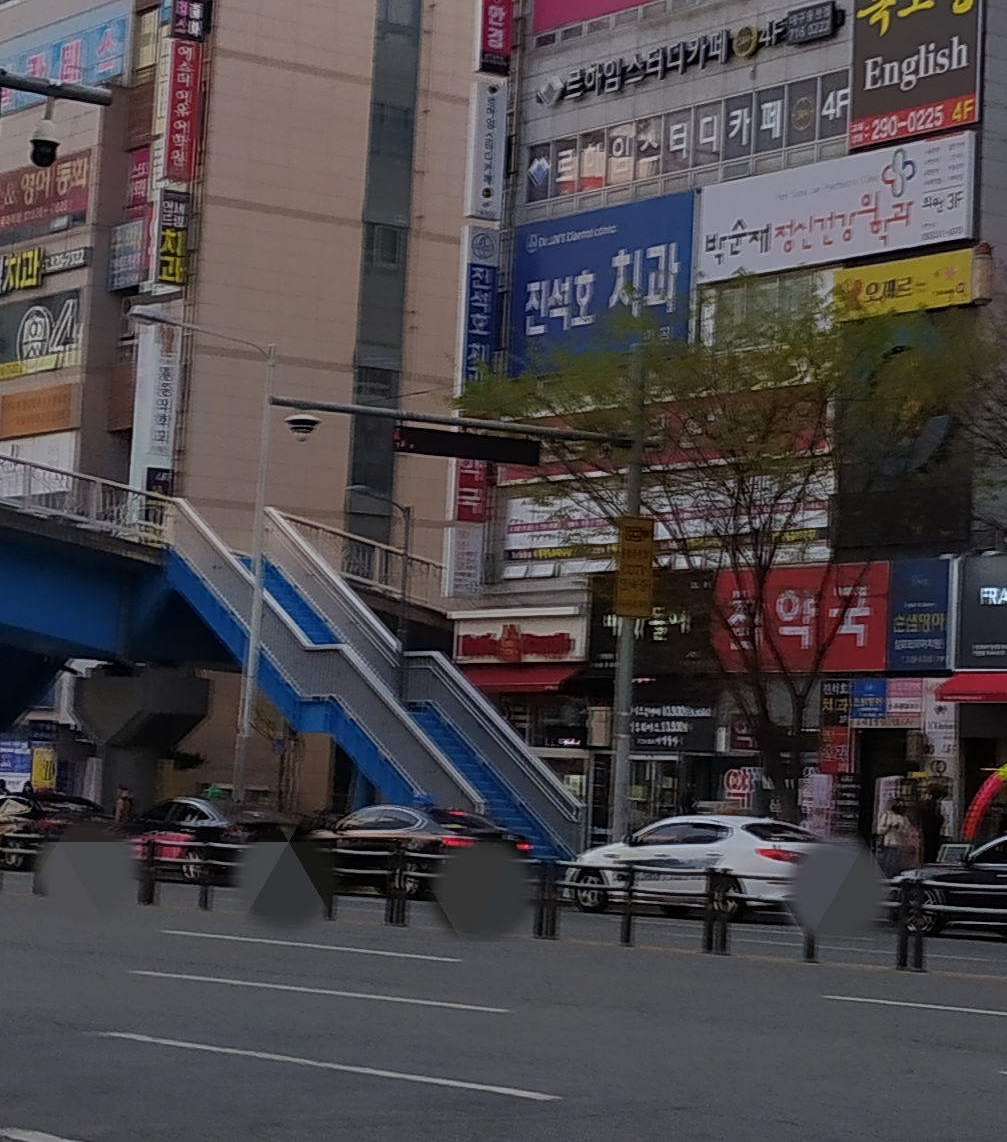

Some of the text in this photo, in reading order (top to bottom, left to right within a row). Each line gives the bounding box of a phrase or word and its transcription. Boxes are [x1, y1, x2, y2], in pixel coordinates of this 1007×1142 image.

[759, 18, 786, 47] 4F
[863, 37, 970, 94] English
[821, 89, 849, 120] 4F
[872, 105, 944, 141] 290-0225
[952, 99, 974, 122] 4F
[21, 167, 51, 205] 영어
[945, 191, 965, 210] 3F
[774, 190, 915, 254] 정신건강의학과
[3, 247, 40, 291] 치과
[160, 229, 184, 283] 치과
[470, 266, 491, 326] 진석호
[525, 242, 680, 336] 진석호 치과
[776, 586, 872, 649] 약국
